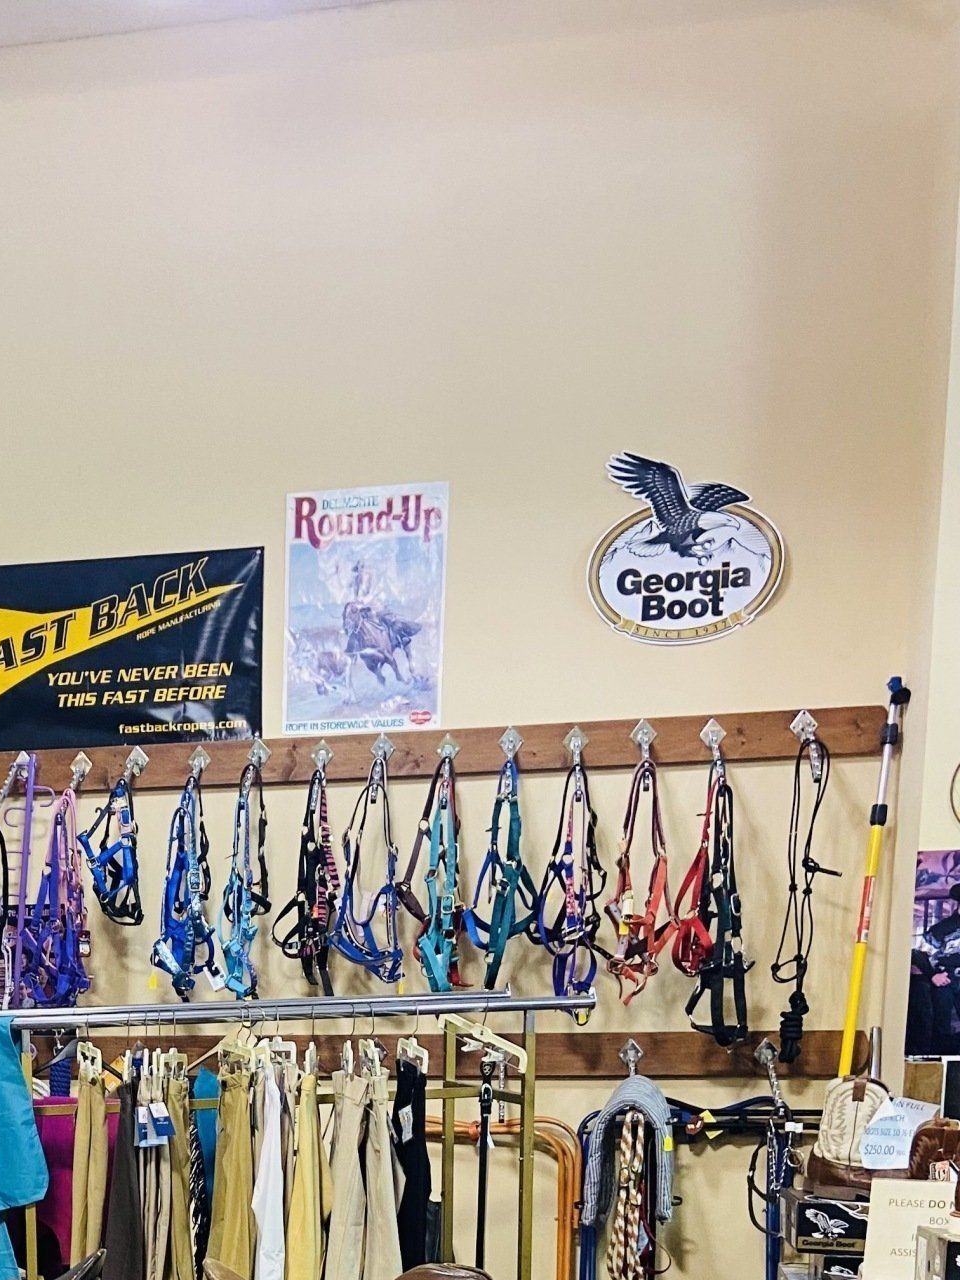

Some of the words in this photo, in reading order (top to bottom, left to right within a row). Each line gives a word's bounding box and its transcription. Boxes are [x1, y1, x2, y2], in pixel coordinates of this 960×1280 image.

[294, 494, 443, 549] Round-Up
[616, 562, 752, 596] Georgia
[88, 556, 209, 640] BACK
[641, 591, 724, 622] Boot
[136, 627, 156, 641] ROPE
[157, 599, 221, 633] MANUFACTURING
[634, 626, 682, 638] SINCE
[694, 620, 728, 636] 1937
[47, 670, 112, 687] YOU'VE
[116, 665, 178, 683] NEVER
[183, 661, 234, 679] BEEN
[57, 692, 97, 708] THIS
[102, 689, 149, 706] FAST
[153, 685, 227, 703] BEFORE
[118, 719, 247, 735] fastbackropes.com
[285, 723, 308, 732] ROPE
[371, 719, 405, 728] VALUES
[864, 1143, 895, 1155] $250.00
[888, 1198, 925, 1208] PLEASE
[928, 1199, 946, 1209] DO
